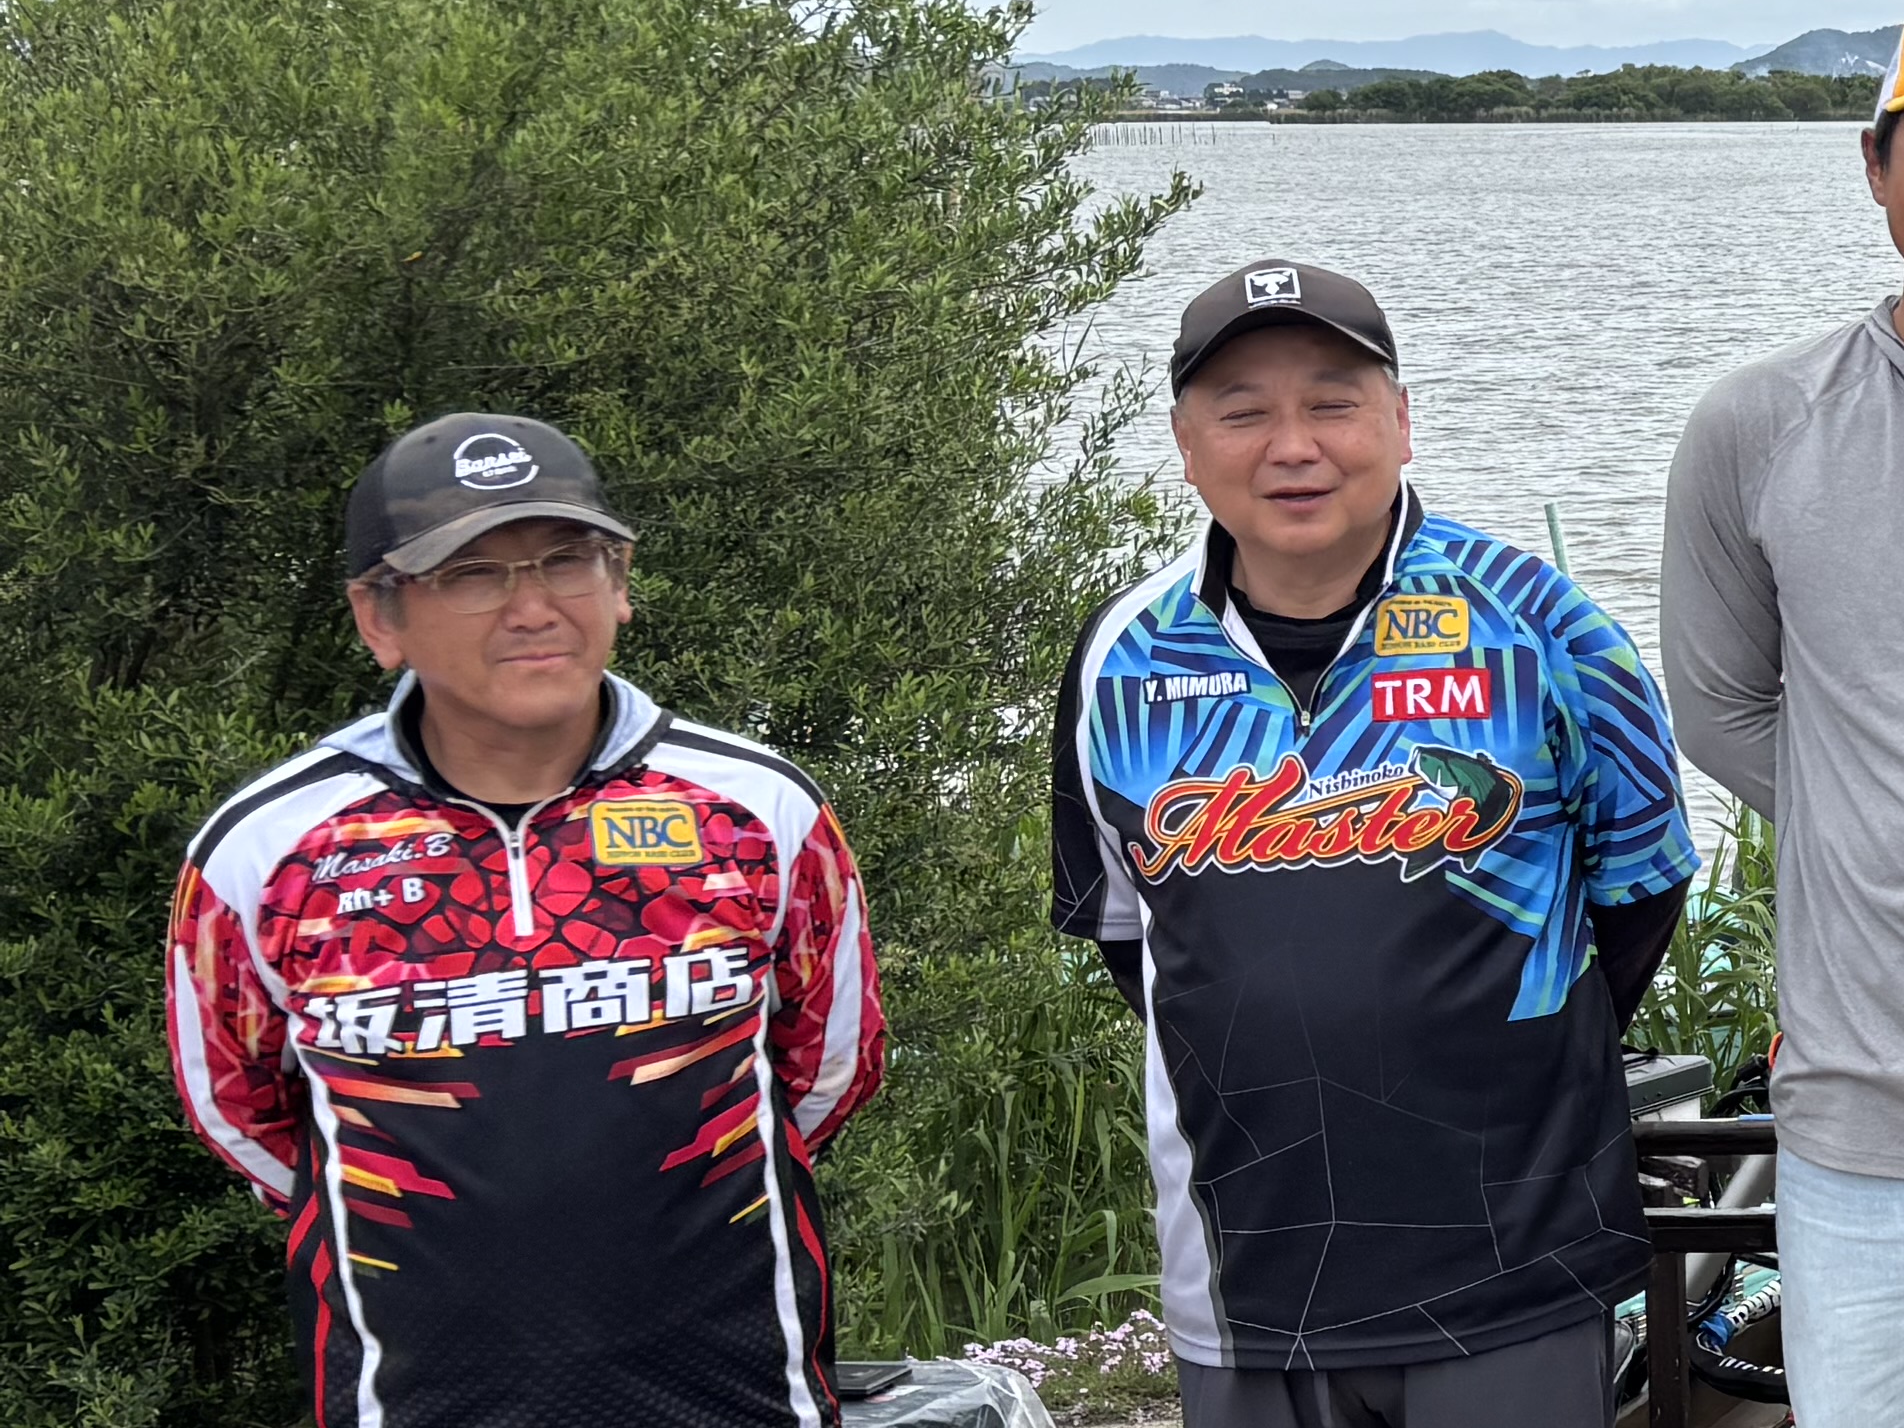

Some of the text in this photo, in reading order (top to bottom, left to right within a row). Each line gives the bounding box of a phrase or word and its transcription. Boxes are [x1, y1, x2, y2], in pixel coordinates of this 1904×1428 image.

[1383, 608, 1461, 641] NBC
[1145, 672, 1248, 703] Y. MIMURA
[1374, 674, 1486, 716] TRM
[1308, 763, 1404, 800] Nishinoko
[601, 813, 694, 849] NBC
[1130, 755, 1523, 878] Master
[336, 876, 426, 915] Rh+ B
[305, 947, 754, 1055] 坂清商店
